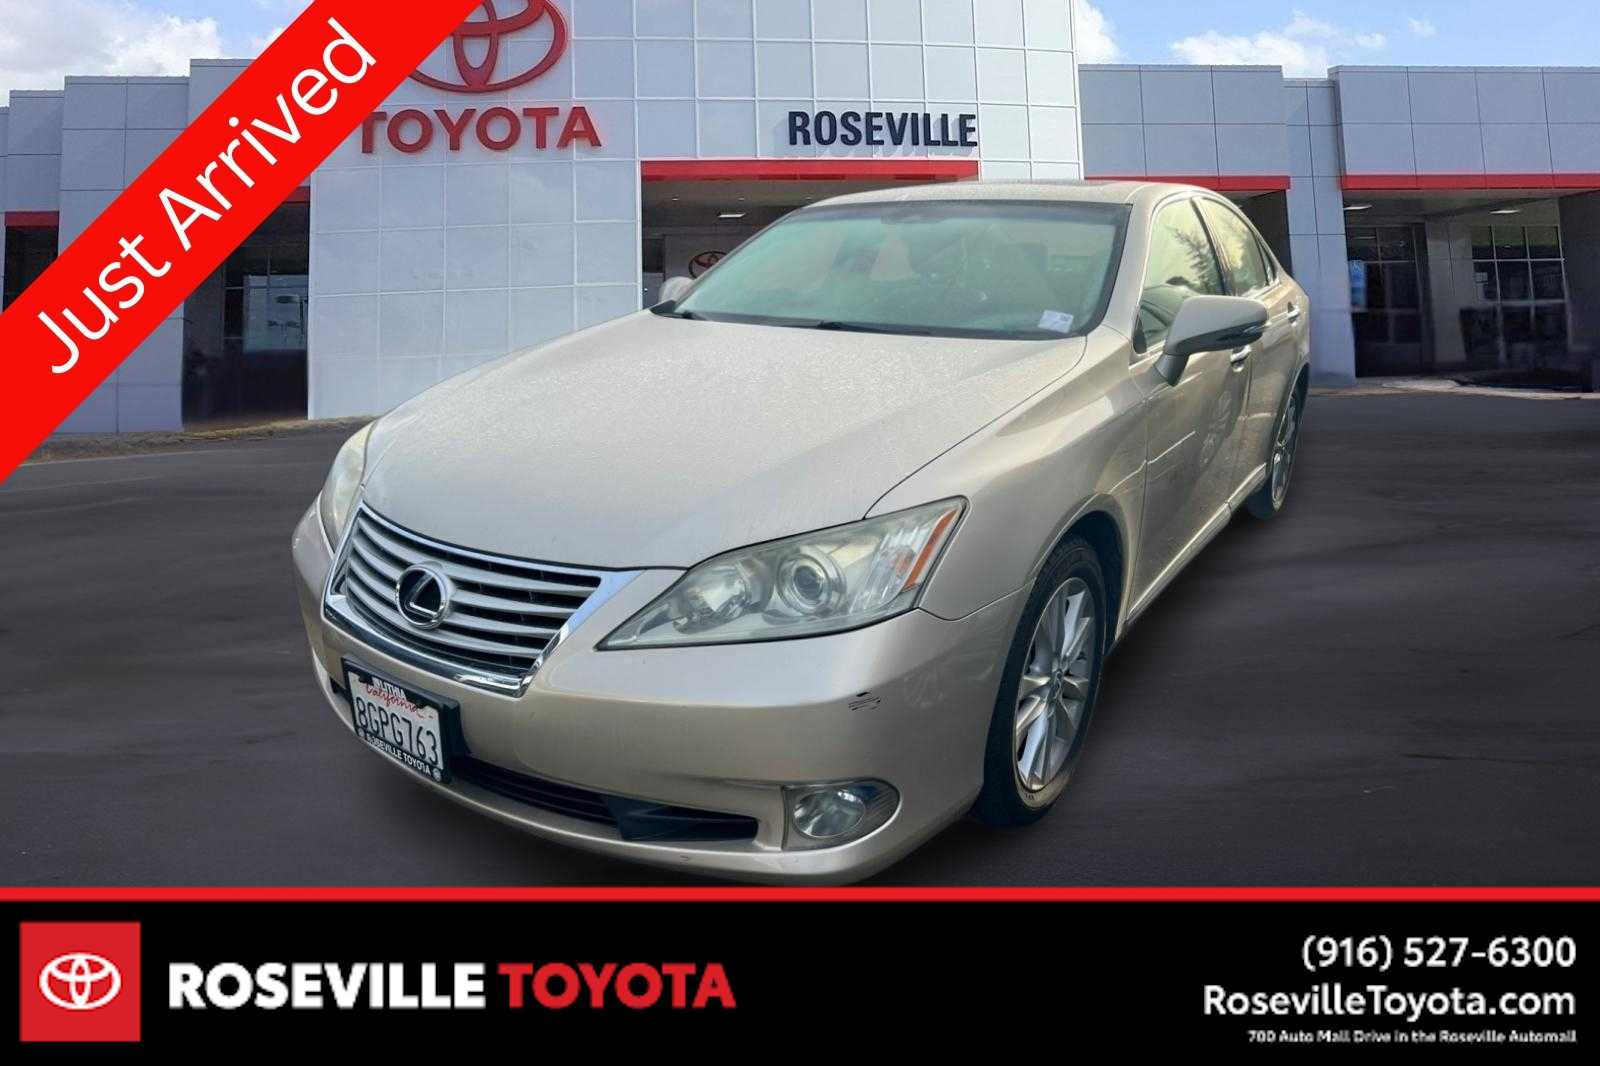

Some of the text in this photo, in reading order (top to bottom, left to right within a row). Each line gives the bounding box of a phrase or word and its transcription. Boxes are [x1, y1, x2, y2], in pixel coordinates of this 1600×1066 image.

[360, 105, 602, 154] TOYOTA
[788, 110, 978, 148] ROSEVILLE
[356, 697, 439, 766] 8GPG763
[402, 753, 431, 774] TOYOTA
